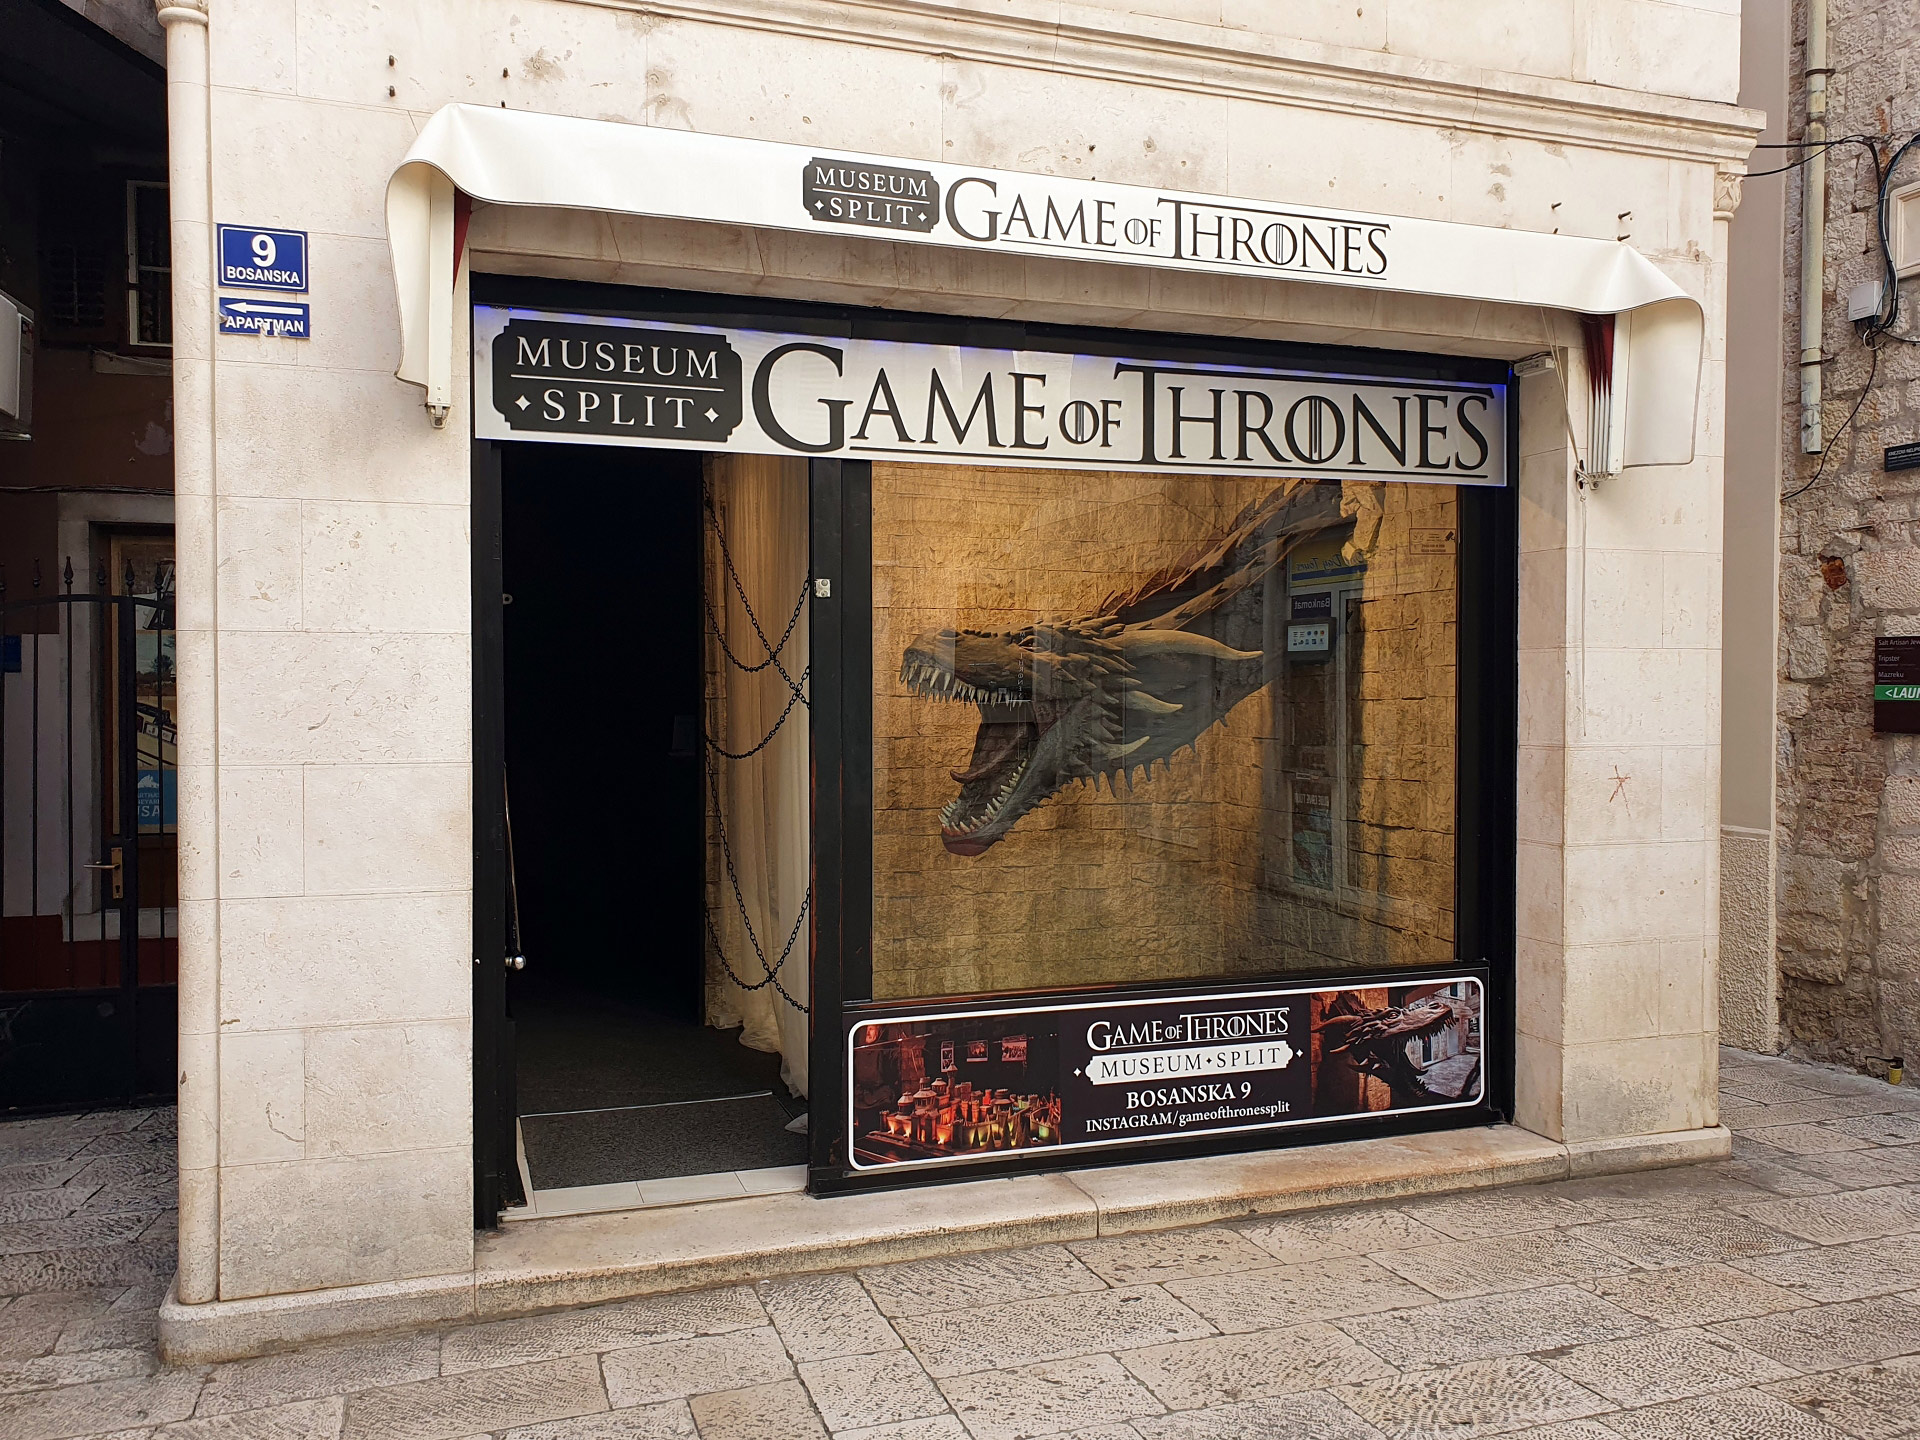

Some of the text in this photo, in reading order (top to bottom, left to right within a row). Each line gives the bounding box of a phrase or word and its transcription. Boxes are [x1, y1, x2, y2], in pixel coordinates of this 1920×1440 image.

[814, 166, 929, 197] MUSEUM
[829, 196, 914, 226] SPLIT
[944, 177, 1391, 276] GAME OF THRONES
[251, 234, 277, 268] 9
[226, 266, 300, 284] BOSANSKA
[224, 315, 304, 333] APARTMAN
[516, 335, 719, 380] MUSEUM
[542, 388, 695, 429] SPLIT
[751, 341, 1495, 471] GAME OF THRONES
[1878, 654, 1900, 663] Tripster
[1086, 1007, 1290, 1052] GAME OF THRONES
[1100, 1047, 1281, 1079] MUSEUM SPLIT
[1126, 1081, 1252, 1110] BOSANSKA 9
[1085, 1100, 1291, 1133] INSTAGRAM/gameofthronessplit
